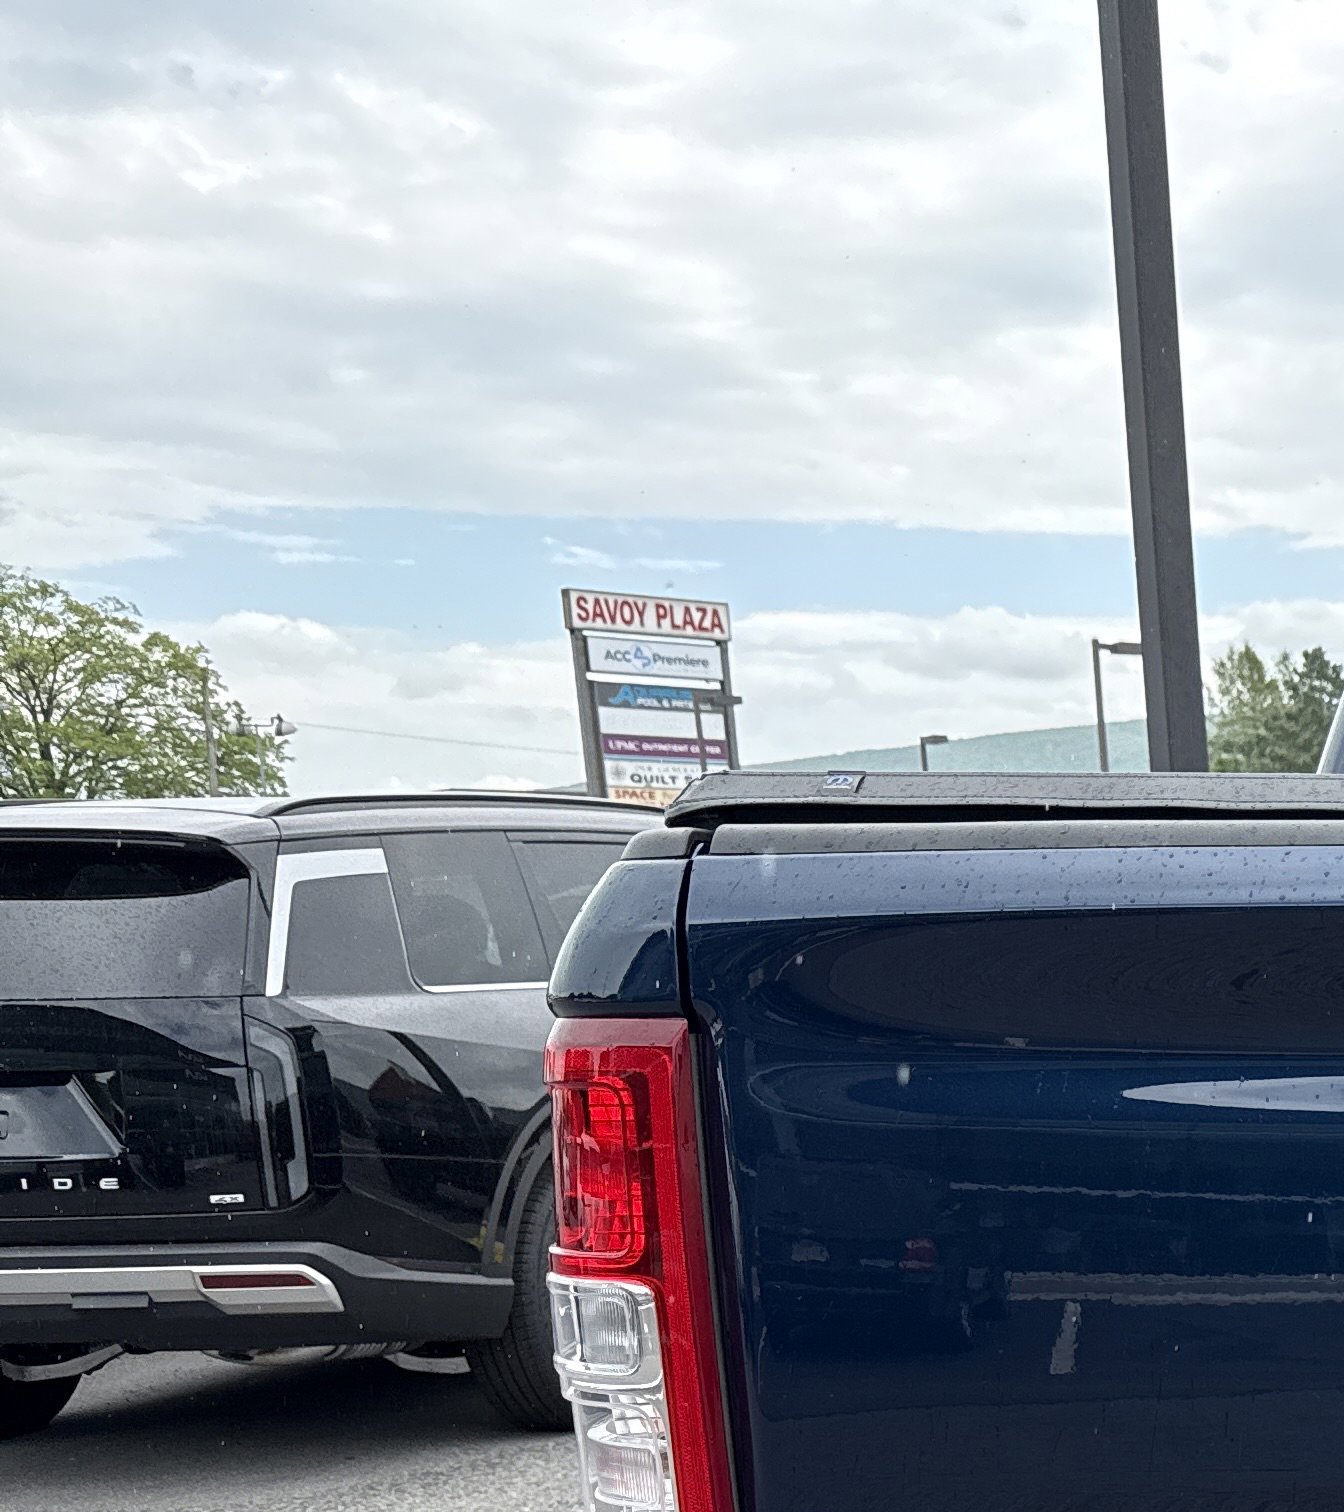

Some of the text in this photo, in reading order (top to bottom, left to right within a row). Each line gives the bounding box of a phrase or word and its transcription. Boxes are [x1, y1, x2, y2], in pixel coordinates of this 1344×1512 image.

[576, 596, 725, 634] SAVOY PLAZA
[604, 650, 709, 668] ACC Premiere
[630, 773, 678, 786] QUILT
[614, 789, 656, 801] SPACE
